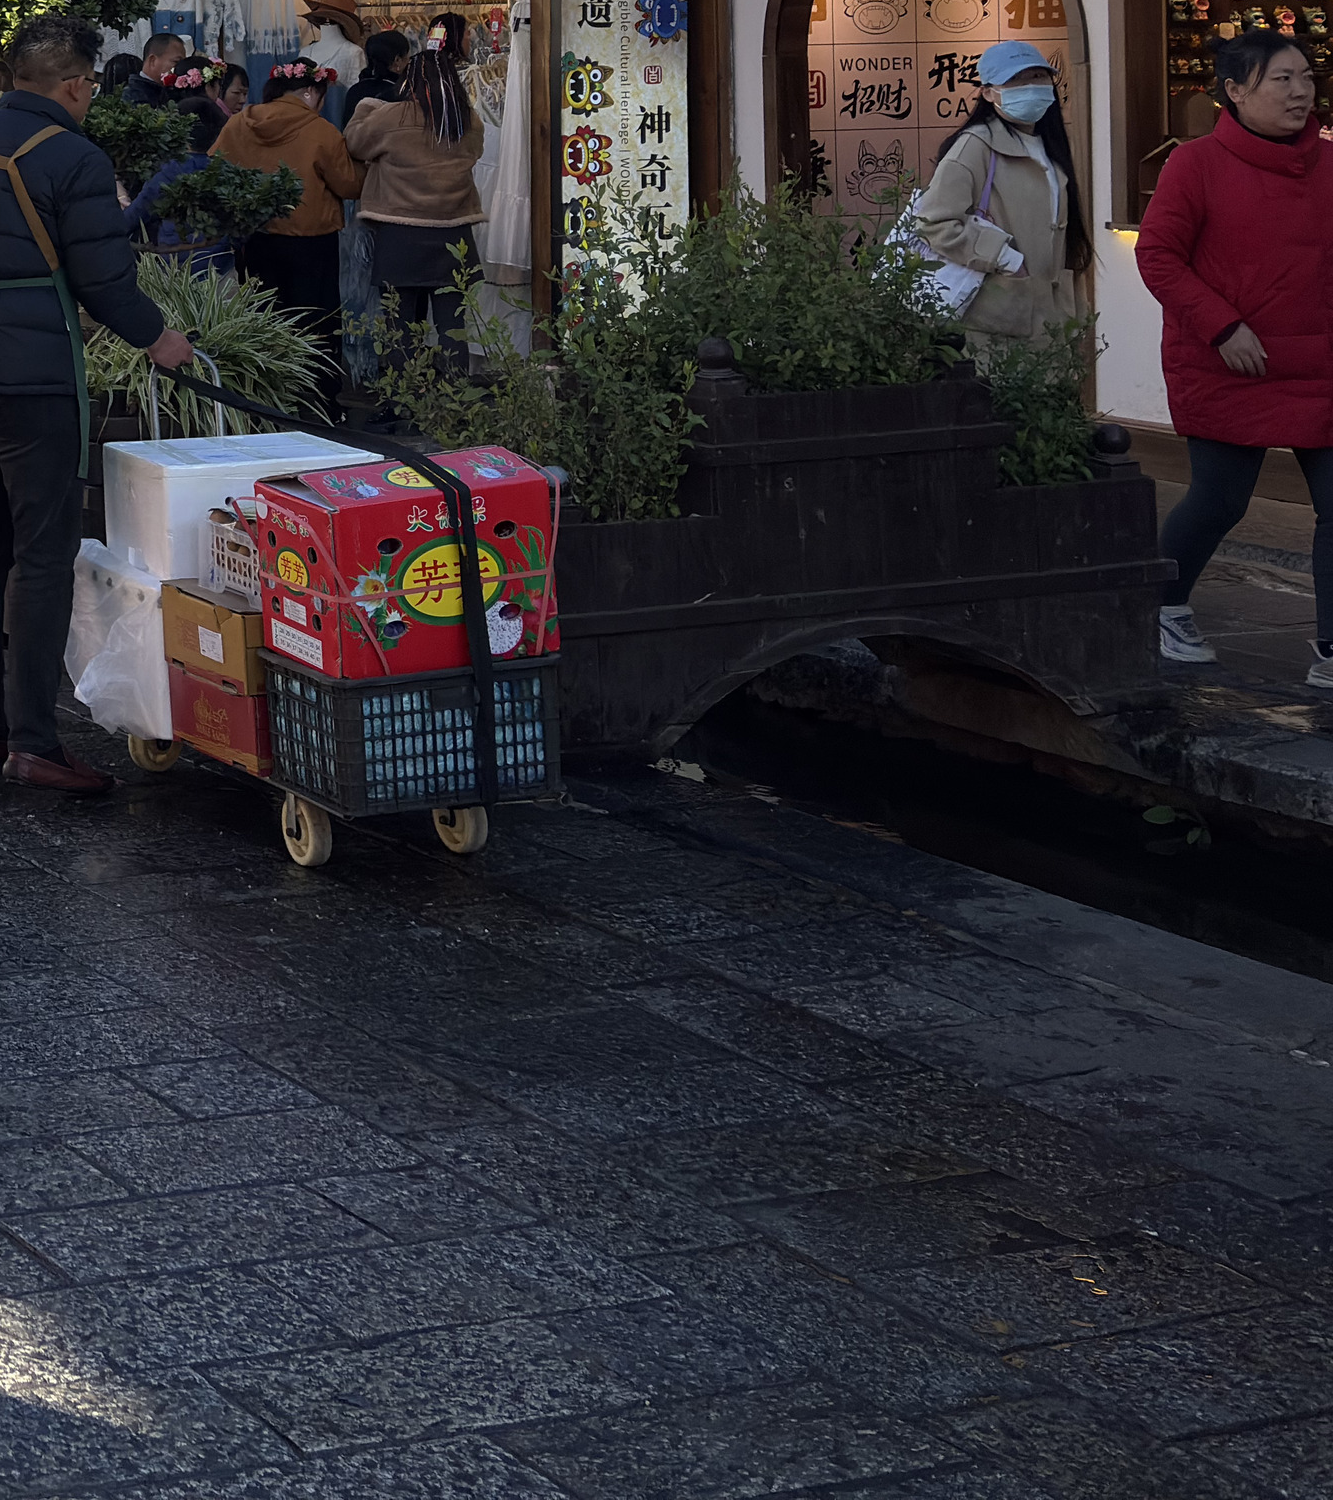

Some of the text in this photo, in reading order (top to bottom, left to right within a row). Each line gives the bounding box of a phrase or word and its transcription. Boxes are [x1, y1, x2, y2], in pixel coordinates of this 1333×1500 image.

[619, 35, 631, 87] Cultural
[839, 57, 913, 71] WONDER
[617, 90, 631, 145] Heritage
[839, 78, 912, 120] 招财
[619, 157, 631, 212] WONDE
[279, 555, 305, 586] 芳芳
